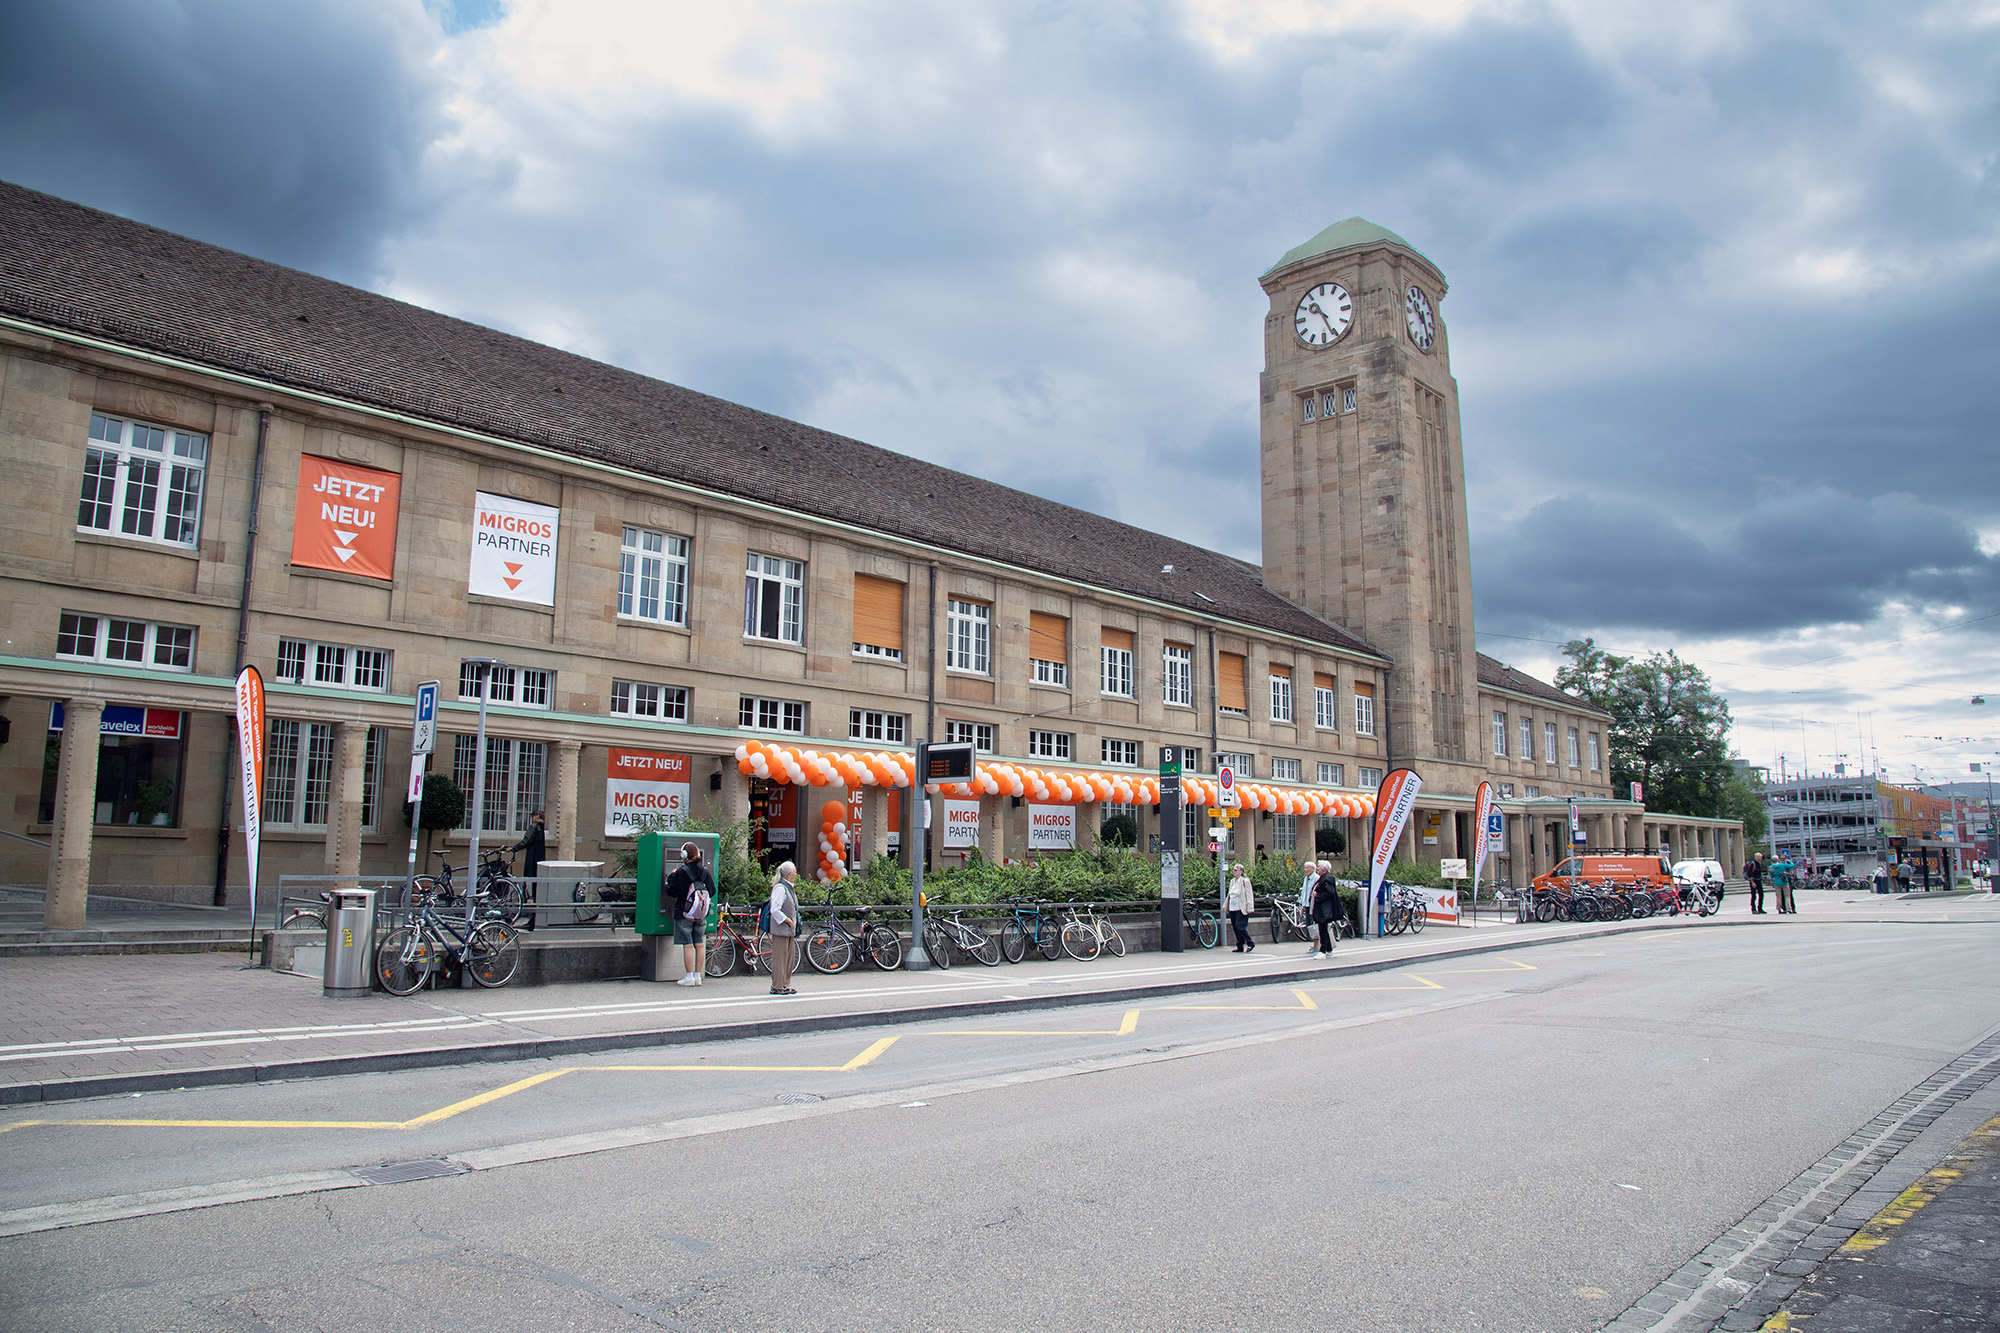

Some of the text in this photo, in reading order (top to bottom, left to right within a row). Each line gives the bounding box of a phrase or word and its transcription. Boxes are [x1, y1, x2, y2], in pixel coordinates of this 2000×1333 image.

[313, 475, 385, 503] JETZT
[321, 503, 376, 529] NEU!
[479, 511, 552, 539] MIGROS
[477, 531, 551, 558] PARTNER
[422, 693, 431, 717] P
[100, 721, 141, 733] avelex
[240, 683, 257, 840] MIGROS PARTNER
[616, 755, 683, 770] JETZT NEU!
[1164, 748, 1173, 763] B
[614, 792, 680, 809] MIGROS
[1383, 798, 1392, 812] Tage
[1033, 814, 1071, 827] MIGROS
[1375, 778, 1417, 866] MIGROS PARTNER
[769, 831, 794, 839] PARTNER
[949, 826, 980, 838] PARTN
[1033, 829, 1071, 841] PARTNER
